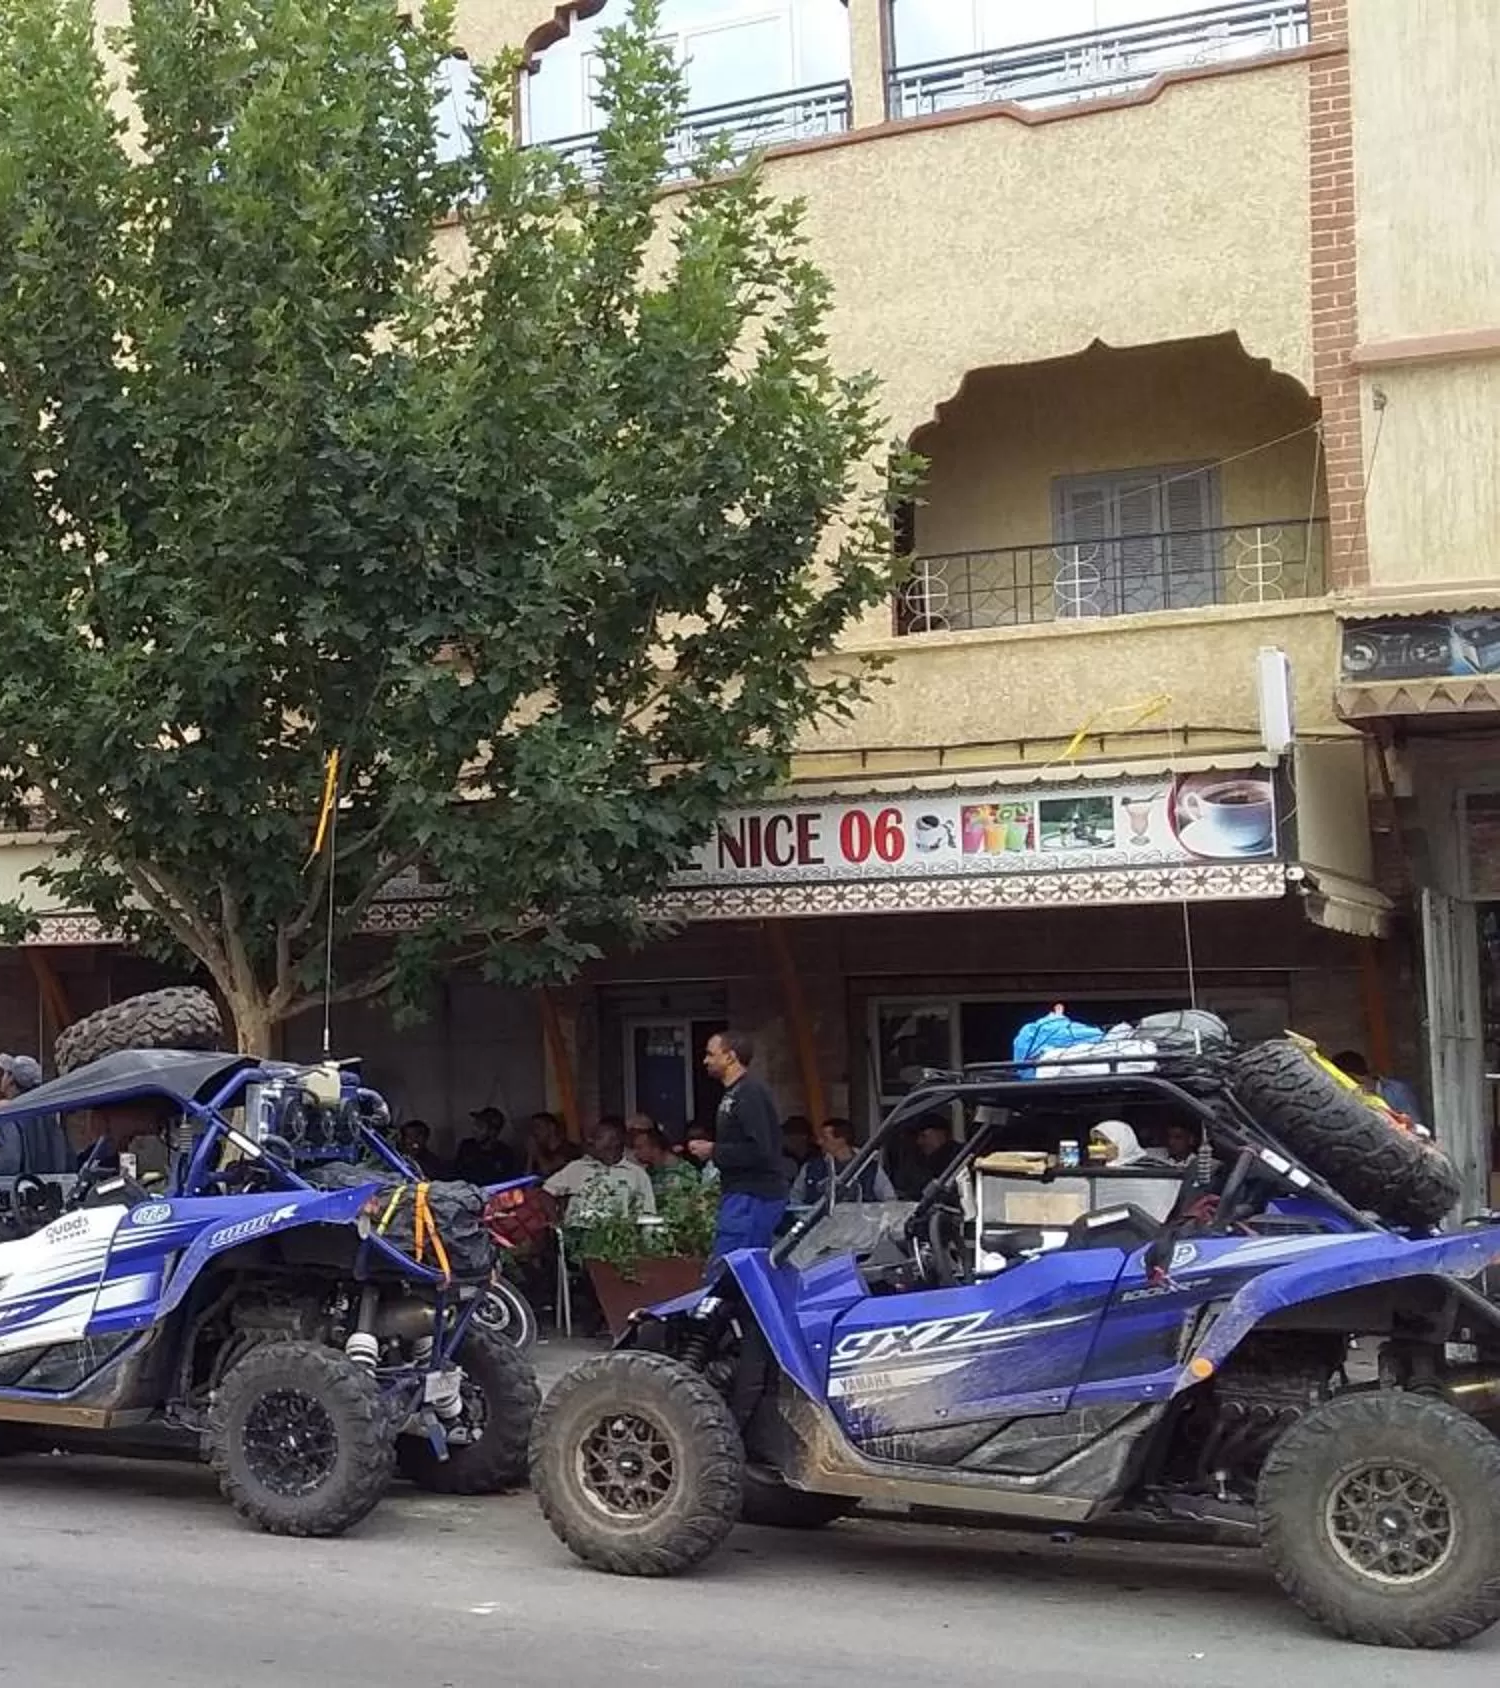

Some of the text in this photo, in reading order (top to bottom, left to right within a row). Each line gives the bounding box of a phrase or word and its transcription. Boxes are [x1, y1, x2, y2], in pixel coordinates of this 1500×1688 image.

[717, 807, 906, 869] NICE 06
[838, 1373, 892, 1393] YAMAHA
